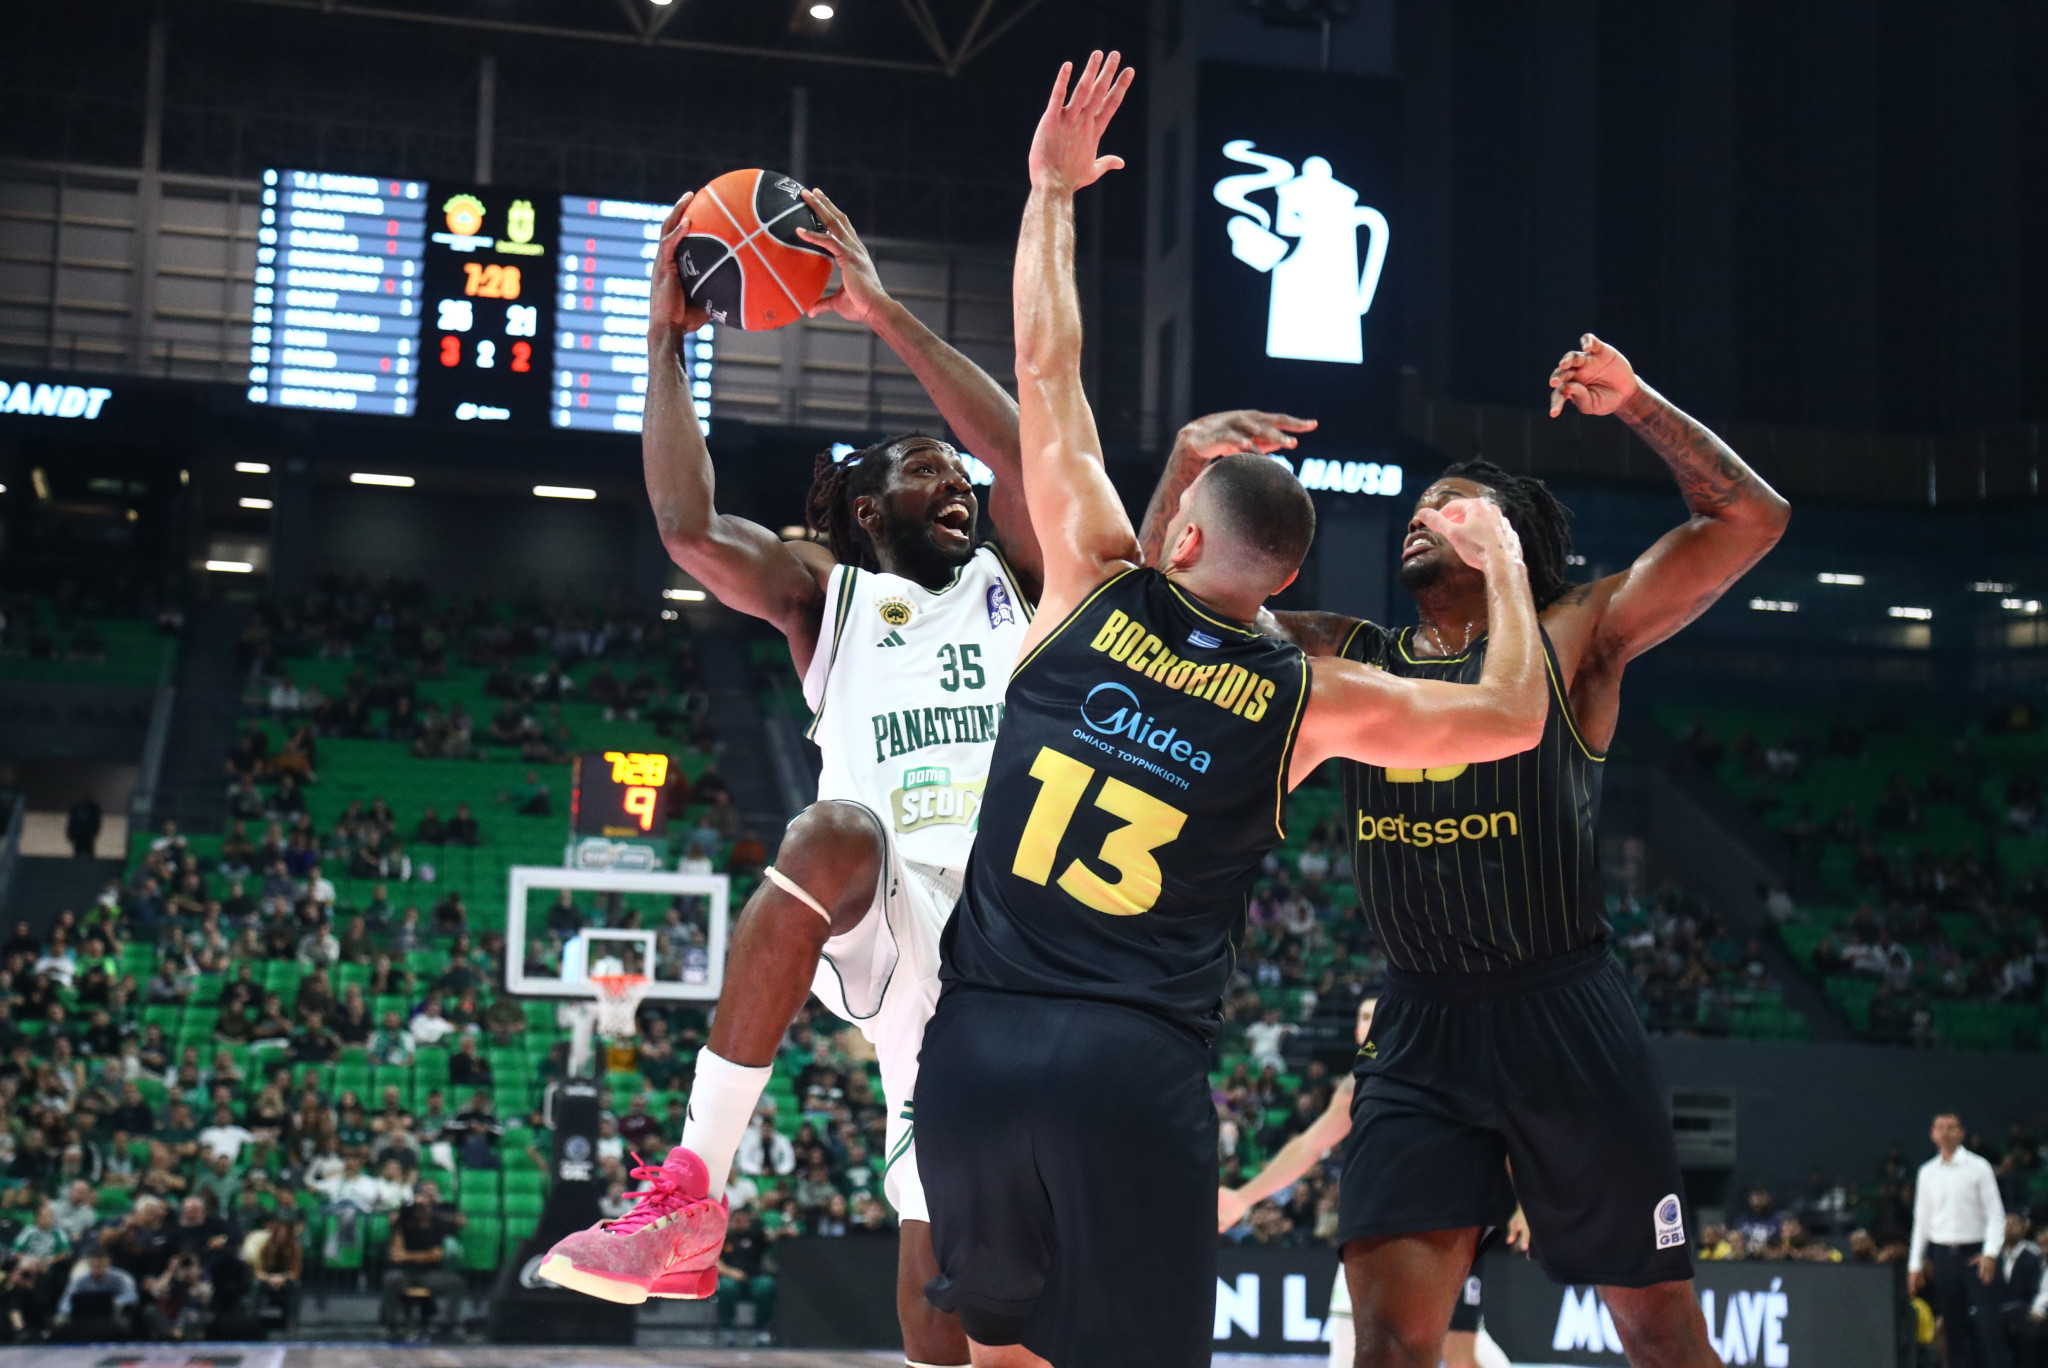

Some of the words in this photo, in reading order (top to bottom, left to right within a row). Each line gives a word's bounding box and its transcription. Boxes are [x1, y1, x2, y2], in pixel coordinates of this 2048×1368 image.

[476, 339, 496, 369] 2
[511, 341, 532, 372] 2
[937, 643, 986, 692] 35
[1090, 609, 1276, 722] BOCHORIDIS
[1072, 728, 1115, 755] ΟΜΙΛΟΣ
[1117, 749, 1190, 790] ΤΟΥΡΝΙΚΙΩΤΗ
[1088, 700, 1212, 774] Midea
[603, 751, 669, 787] 7:28
[906, 769, 947, 788] pame
[624, 785, 657, 832] 9
[1012, 746, 1188, 916] 13
[1358, 809, 1518, 847] betsson
